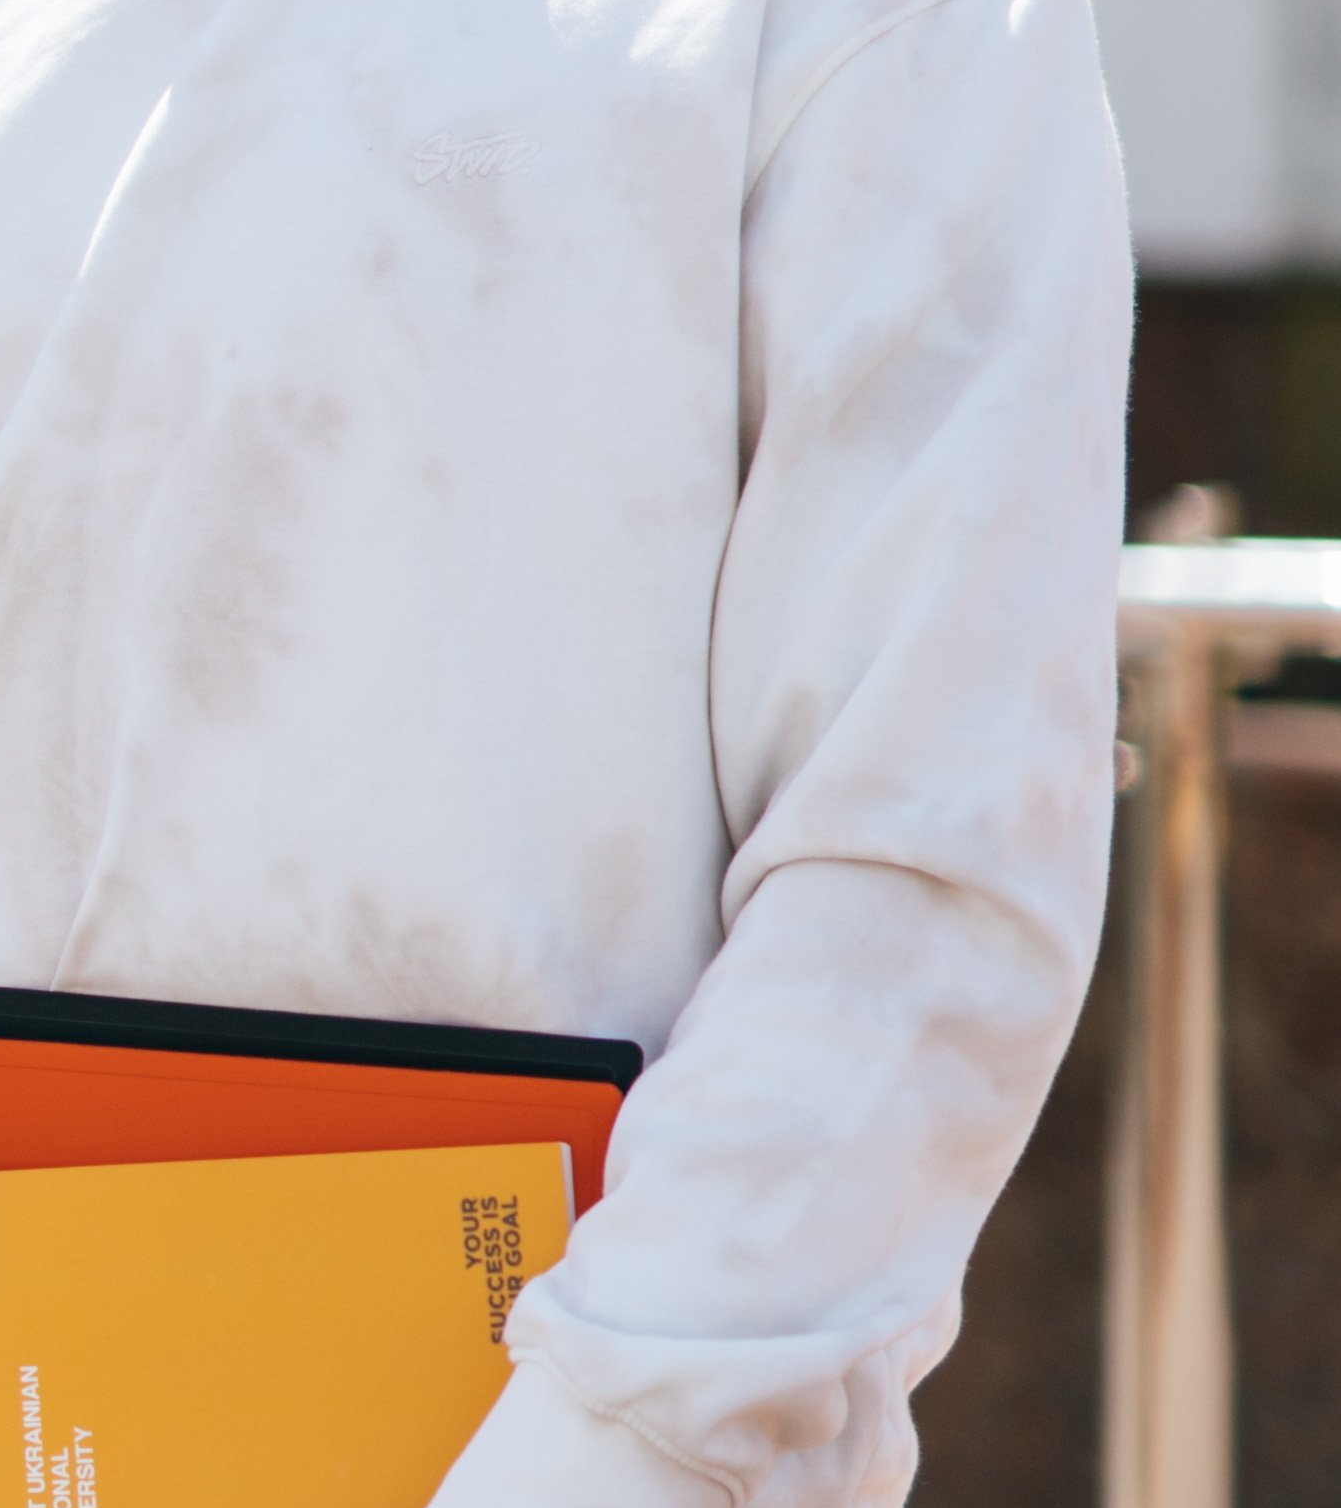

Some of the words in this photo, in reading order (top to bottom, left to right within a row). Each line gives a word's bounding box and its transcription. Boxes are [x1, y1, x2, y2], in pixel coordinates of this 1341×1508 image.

[461, 1197, 482, 1269] YOUR
[480, 1195, 498, 1219] IS
[501, 1195, 523, 1267] GOAL
[483, 1227, 506, 1344] SUCCESS
[20, 1366, 46, 1493] UKRAINIAN
